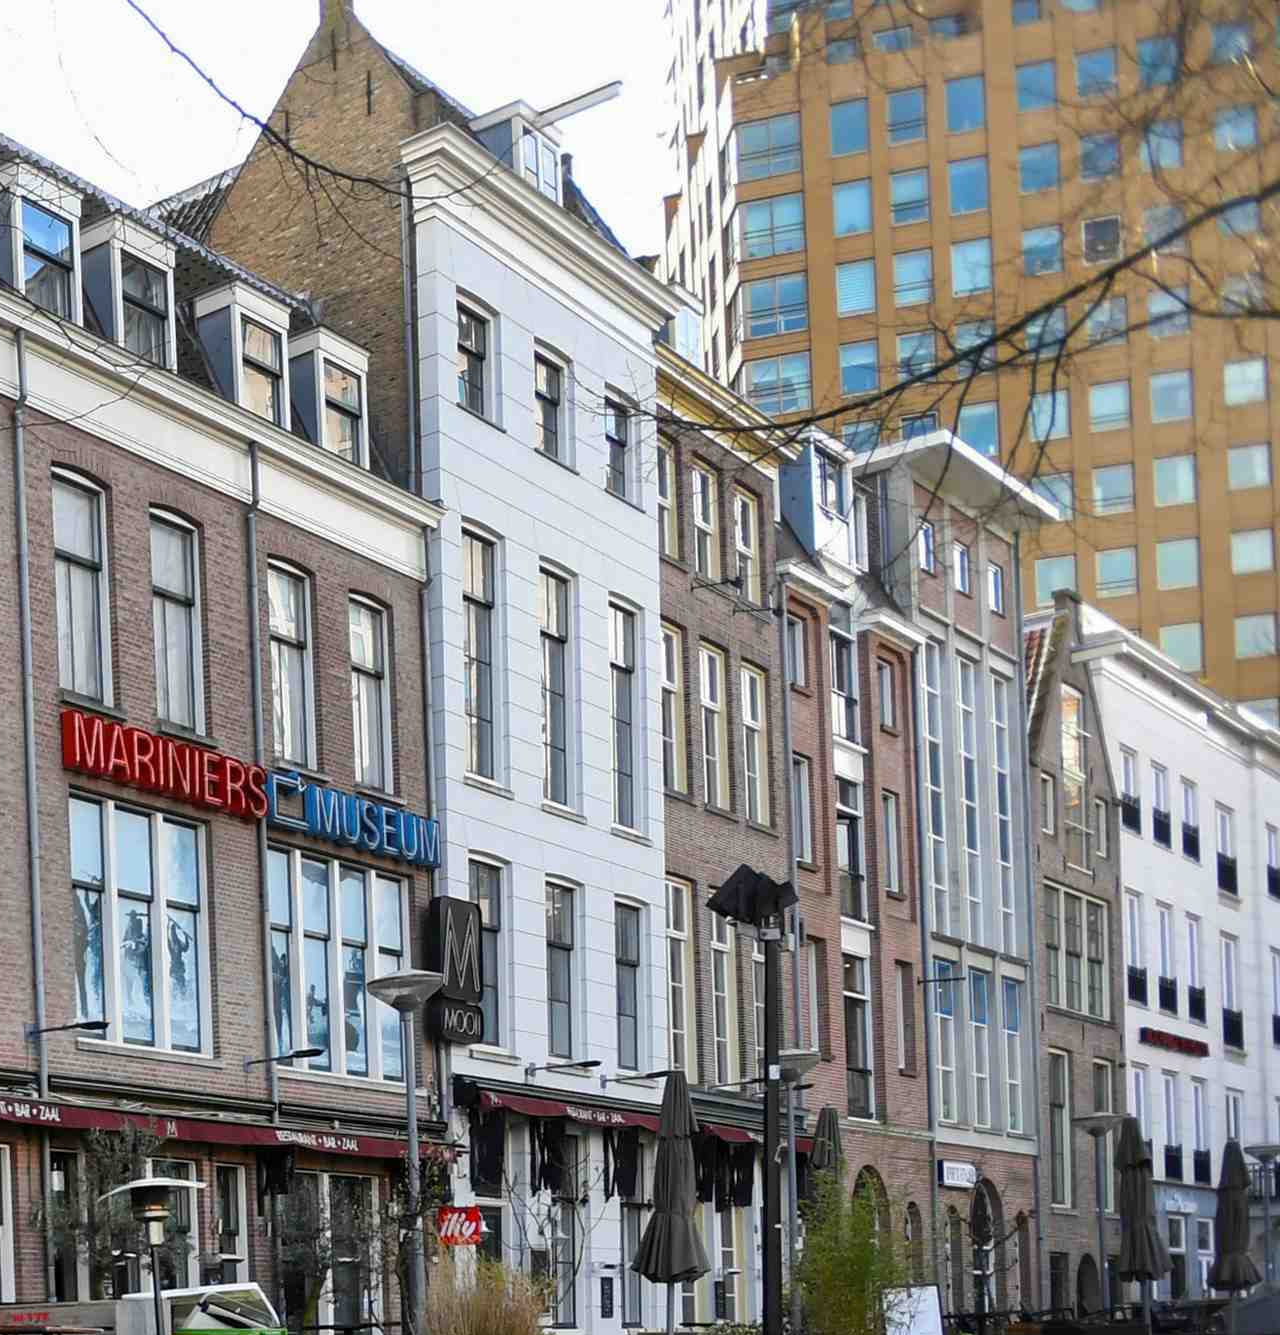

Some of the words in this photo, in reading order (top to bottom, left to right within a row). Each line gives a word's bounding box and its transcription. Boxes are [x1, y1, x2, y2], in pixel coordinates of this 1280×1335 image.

[70, 709, 268, 818] MARINIERS
[313, 784, 440, 867] MUSEUM
[442, 905, 480, 993] M
[14, 1103, 31, 1119] BAR
[40, 1106, 62, 1122] ZAAL
